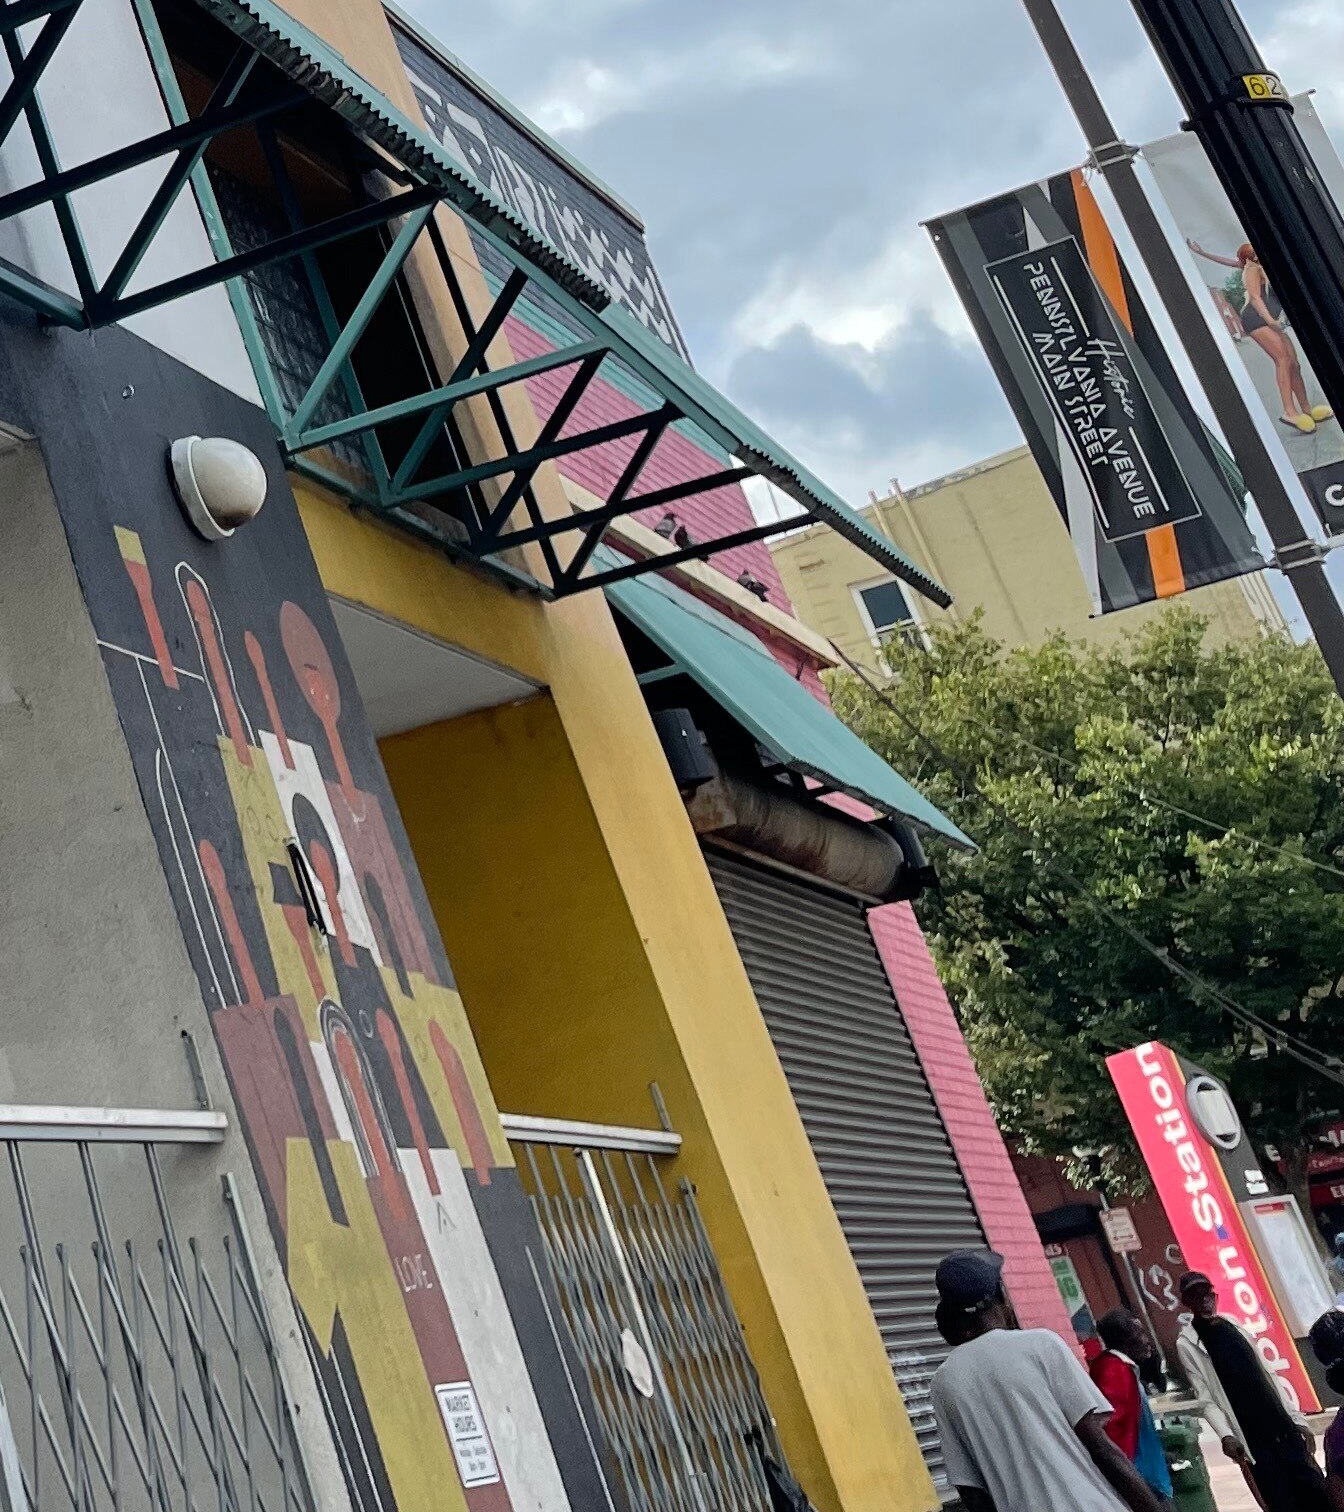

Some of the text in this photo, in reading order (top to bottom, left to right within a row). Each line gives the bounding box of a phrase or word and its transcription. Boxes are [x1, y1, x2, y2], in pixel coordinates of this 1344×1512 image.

[1248, 75, 1282, 97] 62
[1023, 260, 1157, 520] PENNSYLVANIA AVENUE
[1031, 332, 1110, 468] MAIN STREET
[1084, 337, 1136, 420] Historic
[1134, 1041, 1225, 1233] Station
